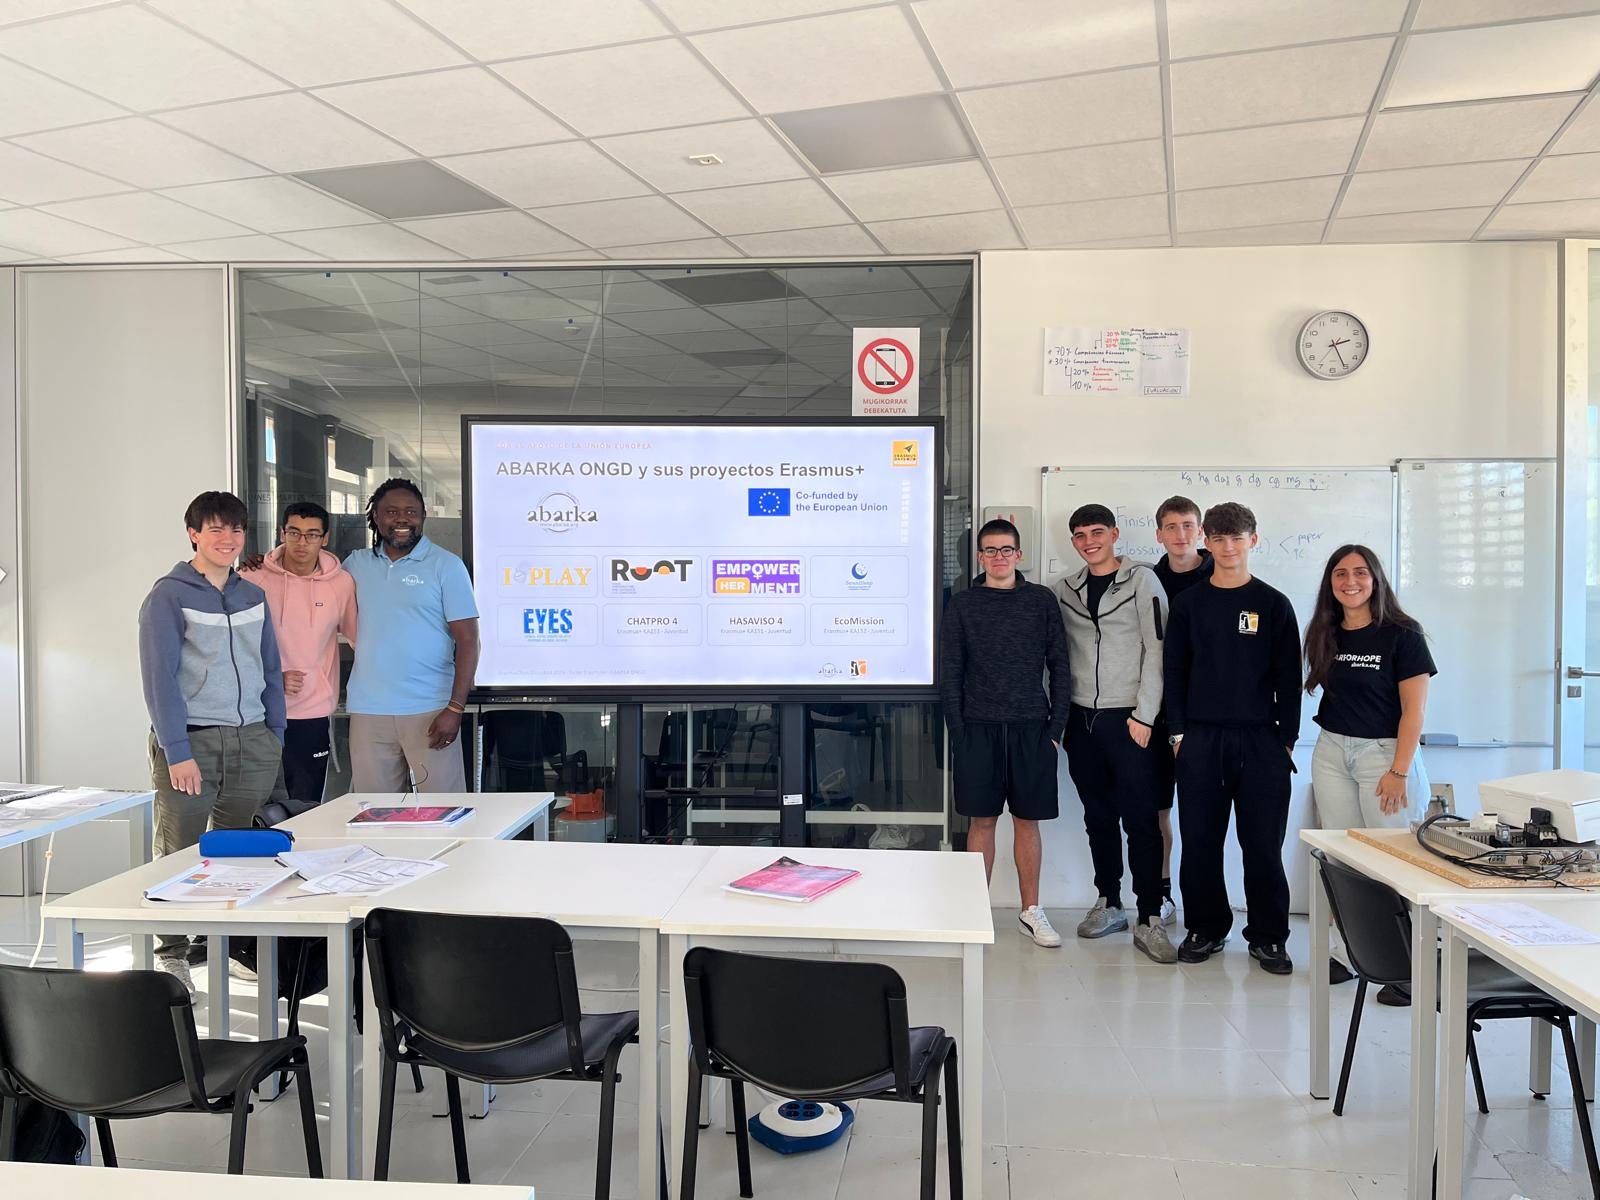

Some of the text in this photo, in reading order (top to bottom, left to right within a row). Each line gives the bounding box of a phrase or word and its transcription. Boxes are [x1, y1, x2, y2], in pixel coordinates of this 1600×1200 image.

[496, 462, 865, 480] ABARKA ONGD y sus proyectos Erasmus+
[796, 492, 858, 502] Co-funded by
[528, 505, 599, 522] abarka
[796, 503, 888, 513] the European Union
[1116, 506, 1155, 528] Finish
[716, 563, 800, 577] EMPOWER
[528, 567, 592, 586] PLAY
[720, 582, 745, 590] HER
[751, 582, 799, 594] MENT
[523, 608, 574, 634] EYES
[627, 617, 678, 625] CHATPRO 4
[730, 617, 784, 625] HASAVISO 4
[834, 616, 884, 625] EcoMission
